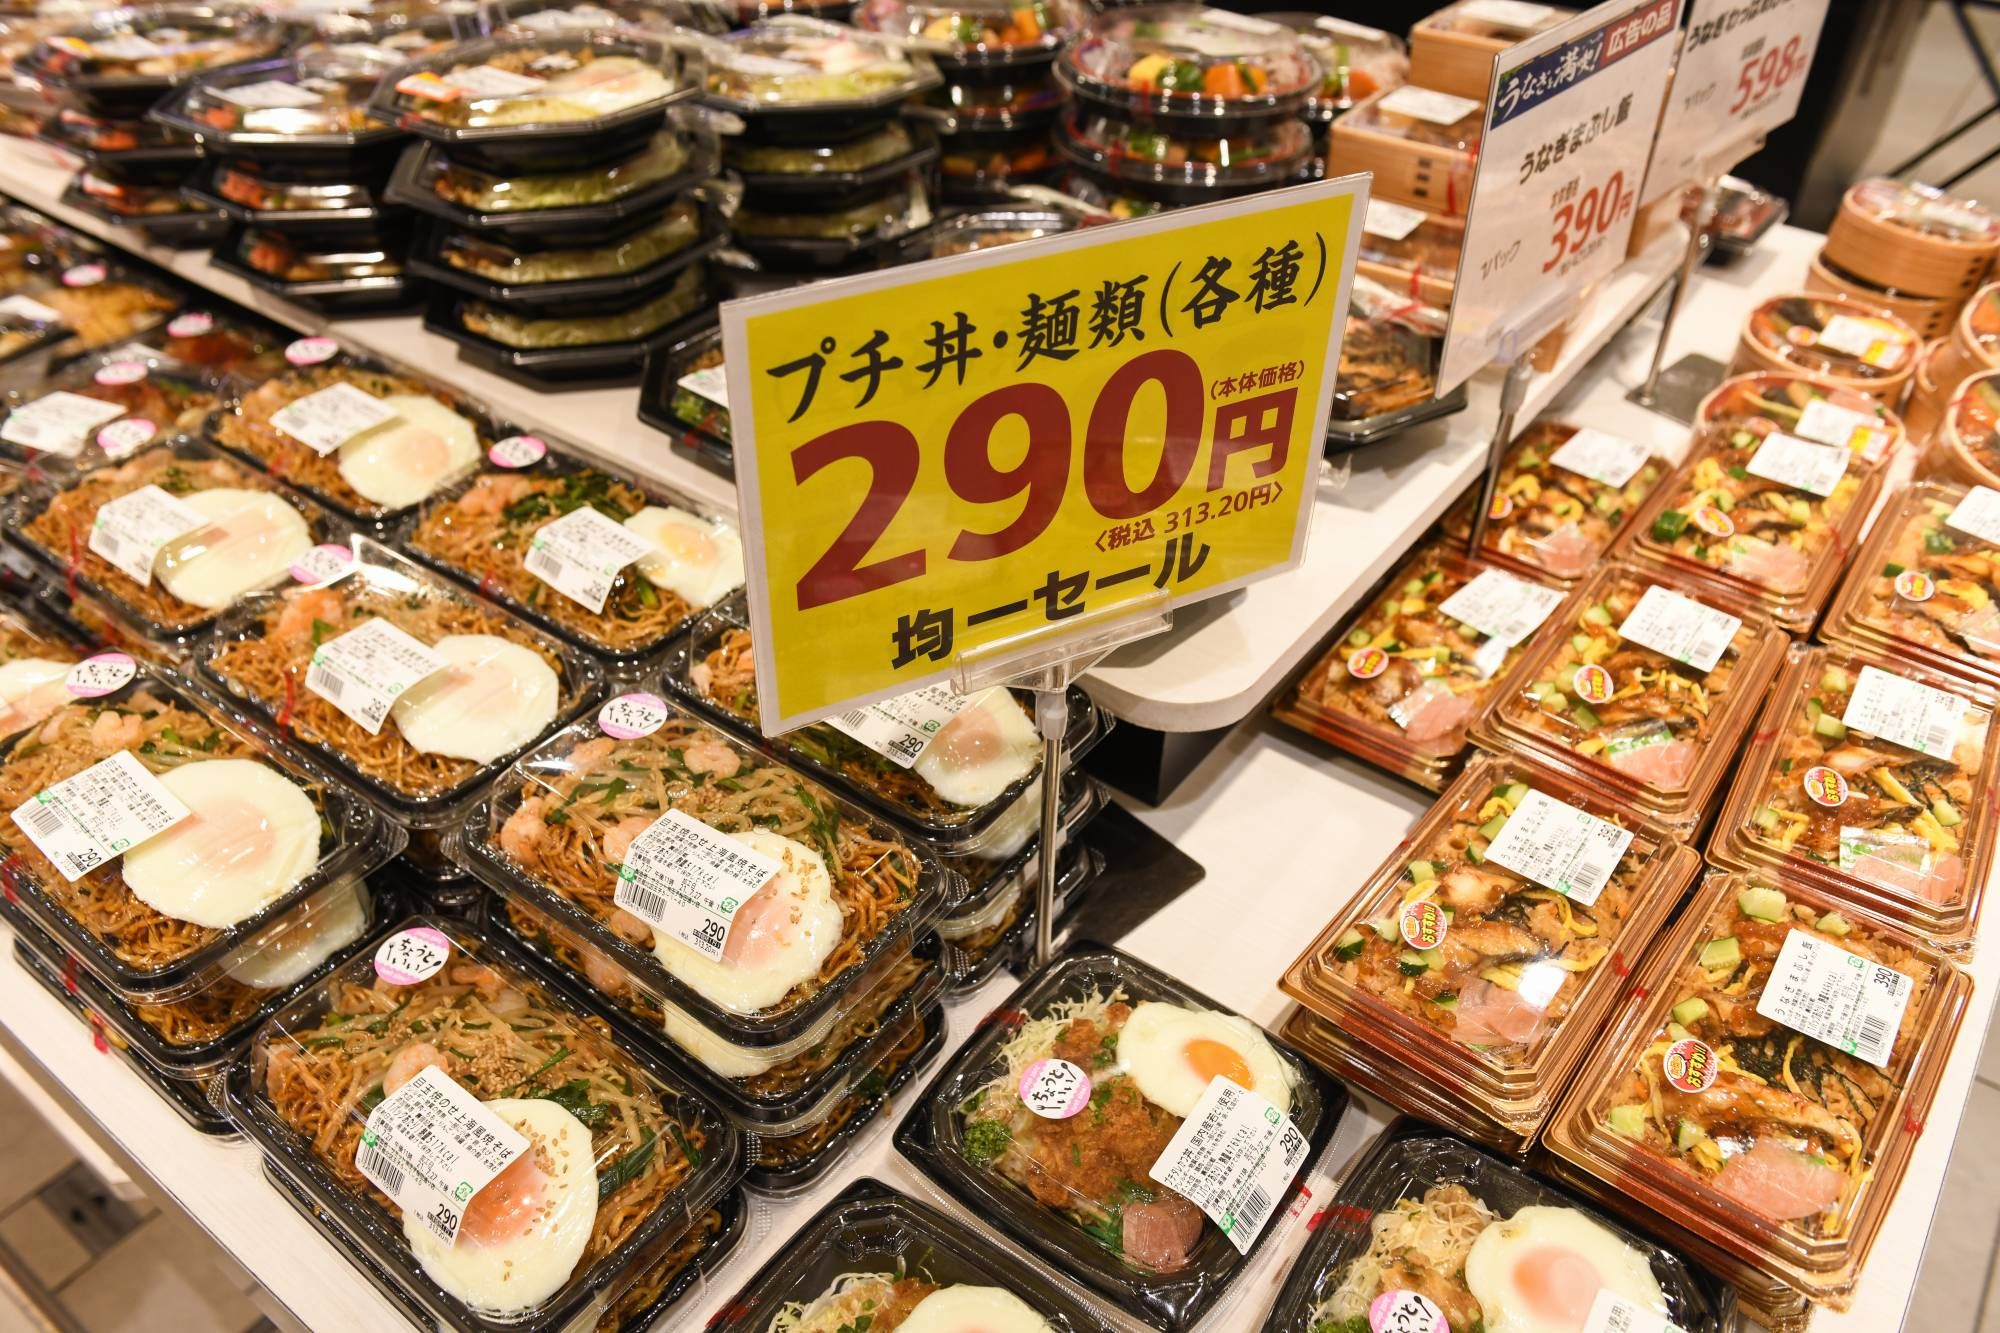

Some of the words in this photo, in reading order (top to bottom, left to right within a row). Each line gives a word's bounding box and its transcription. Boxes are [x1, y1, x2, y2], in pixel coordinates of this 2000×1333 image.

[1607, 2, 1673, 58] 広告の品
[1542, 169, 1635, 274] 390円
[766, 232, 1327, 424] プチ丼・麺類(各種)
[1210, 359, 1305, 401] (本体価格)
[891, 531, 1211, 670] 均一セール
[900, 733, 924, 753] 290
[78, 848, 102, 868] 290
[702, 918, 726, 942] 290
[1874, 967, 1893, 989] 390
[1686, 1043, 1709, 1089] おすすめ!!
[1032, 1069, 1065, 1101] ちょうど
[412, 1075, 514, 1161] 目玉焼のせ上海風焼そば
[1280, 1127, 1299, 1154] 290
[436, 1203, 458, 1230] 290
